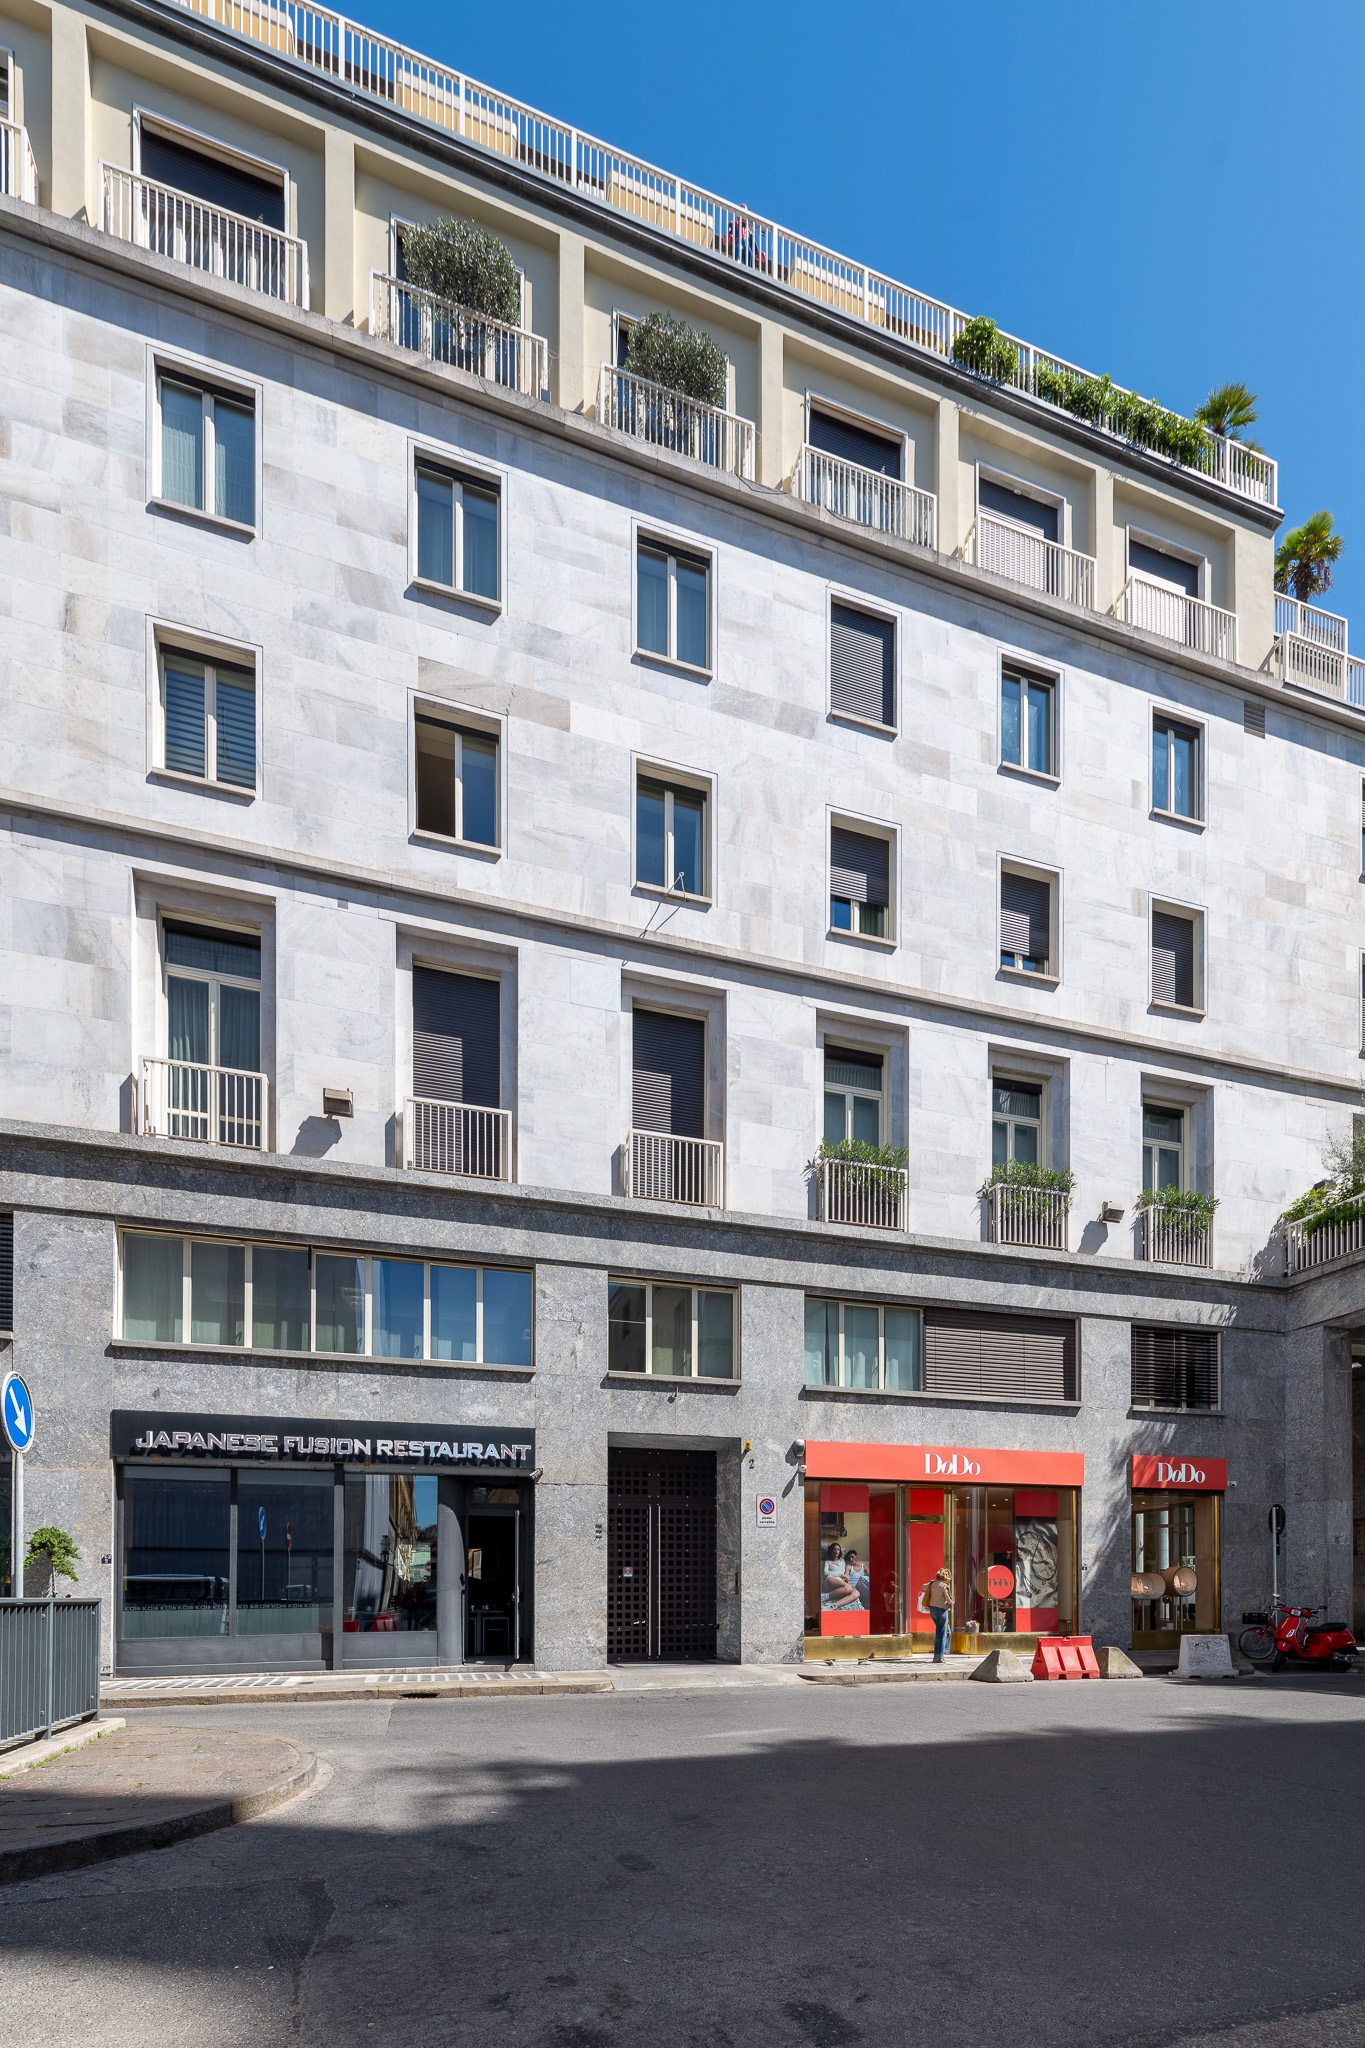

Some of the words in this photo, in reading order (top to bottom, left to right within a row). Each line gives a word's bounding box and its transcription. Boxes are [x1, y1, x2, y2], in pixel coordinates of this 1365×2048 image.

[135, 1431, 278, 1452] JAPANESE
[283, 1436, 371, 1455] FUSION
[376, 1439, 531, 1460] RESTAURANT
[748, 1458, 755, 1470] 2
[924, 1453, 981, 1476] DoDo
[1157, 1462, 1206, 1484] DoDo
[988, 1577, 1012, 1587] DoDo
